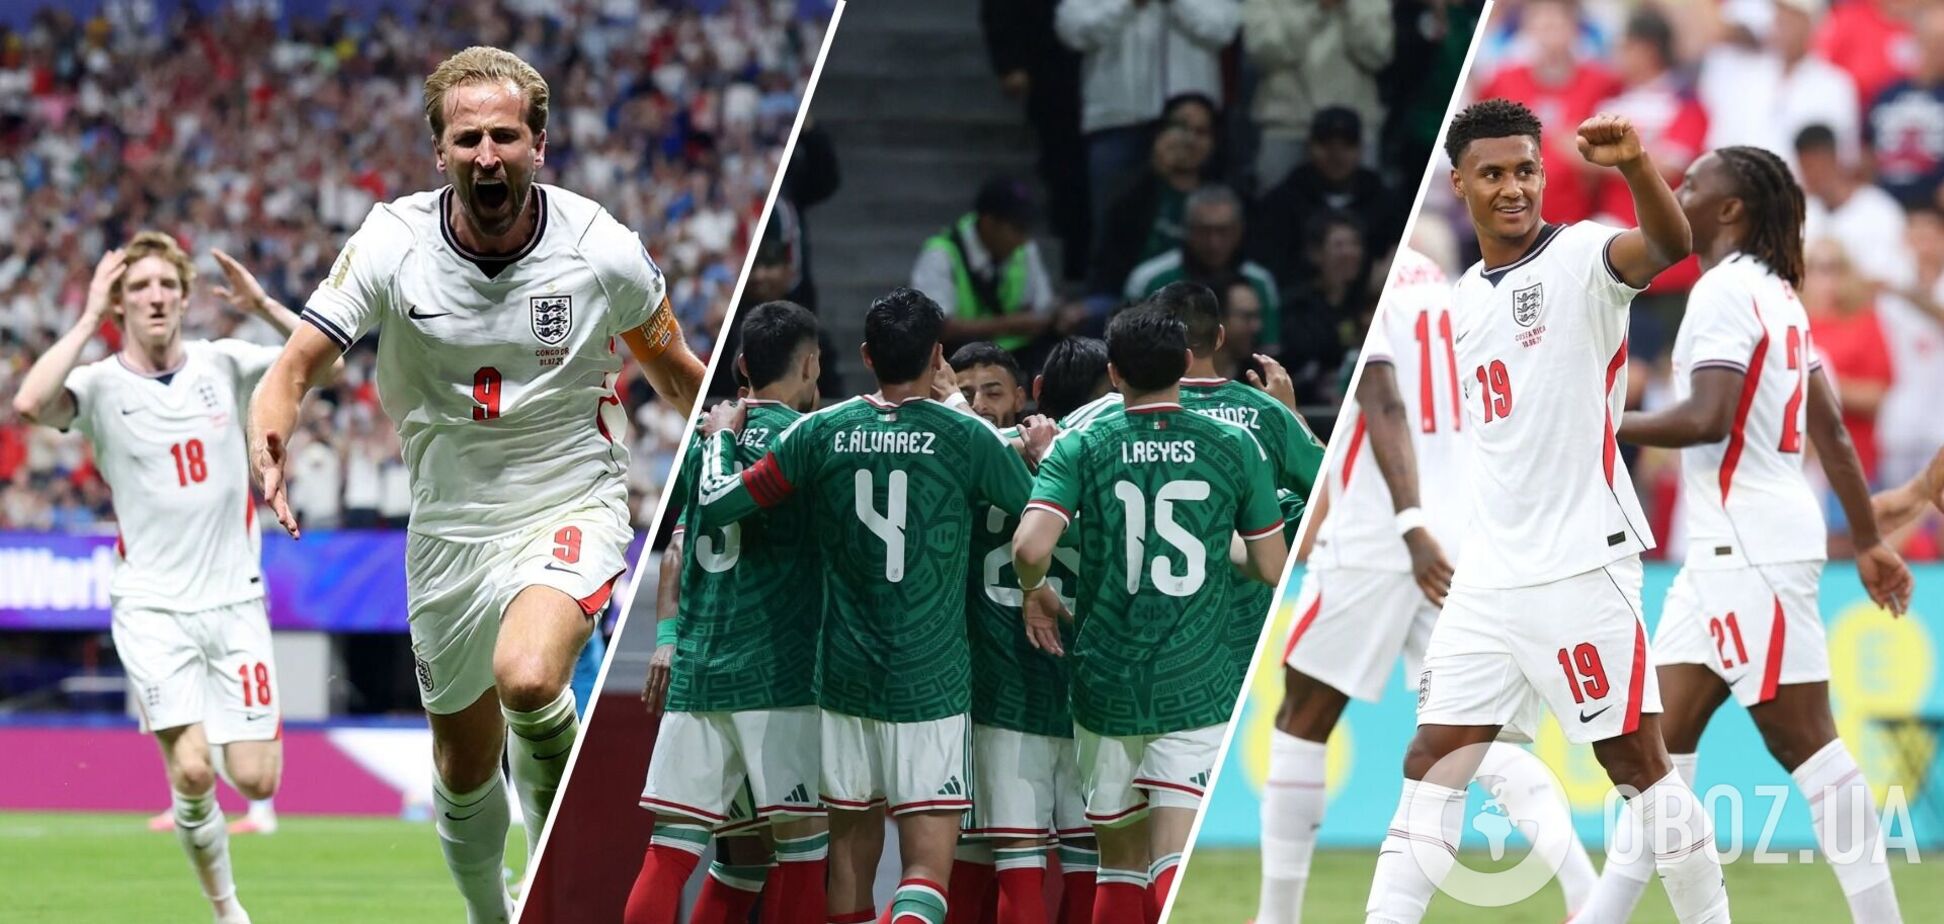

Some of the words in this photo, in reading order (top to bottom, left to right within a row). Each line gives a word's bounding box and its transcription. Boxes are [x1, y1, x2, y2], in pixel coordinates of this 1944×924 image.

[473, 366, 502, 420] 9
[1415, 310, 1461, 433] 11
[1476, 359, 1512, 424] 19
[1778, 325, 1810, 453] 2
[171, 438, 208, 487] 18
[834, 425, 936, 454] E.ÁLVAREZ
[1122, 440, 1195, 464] I.REYES
[553, 526, 582, 564] 9
[855, 468, 908, 583] 4
[1115, 480, 1211, 597] 15
[1710, 611, 1748, 669] 21
[239, 662, 271, 707] 18
[1557, 642, 1610, 704] 19
